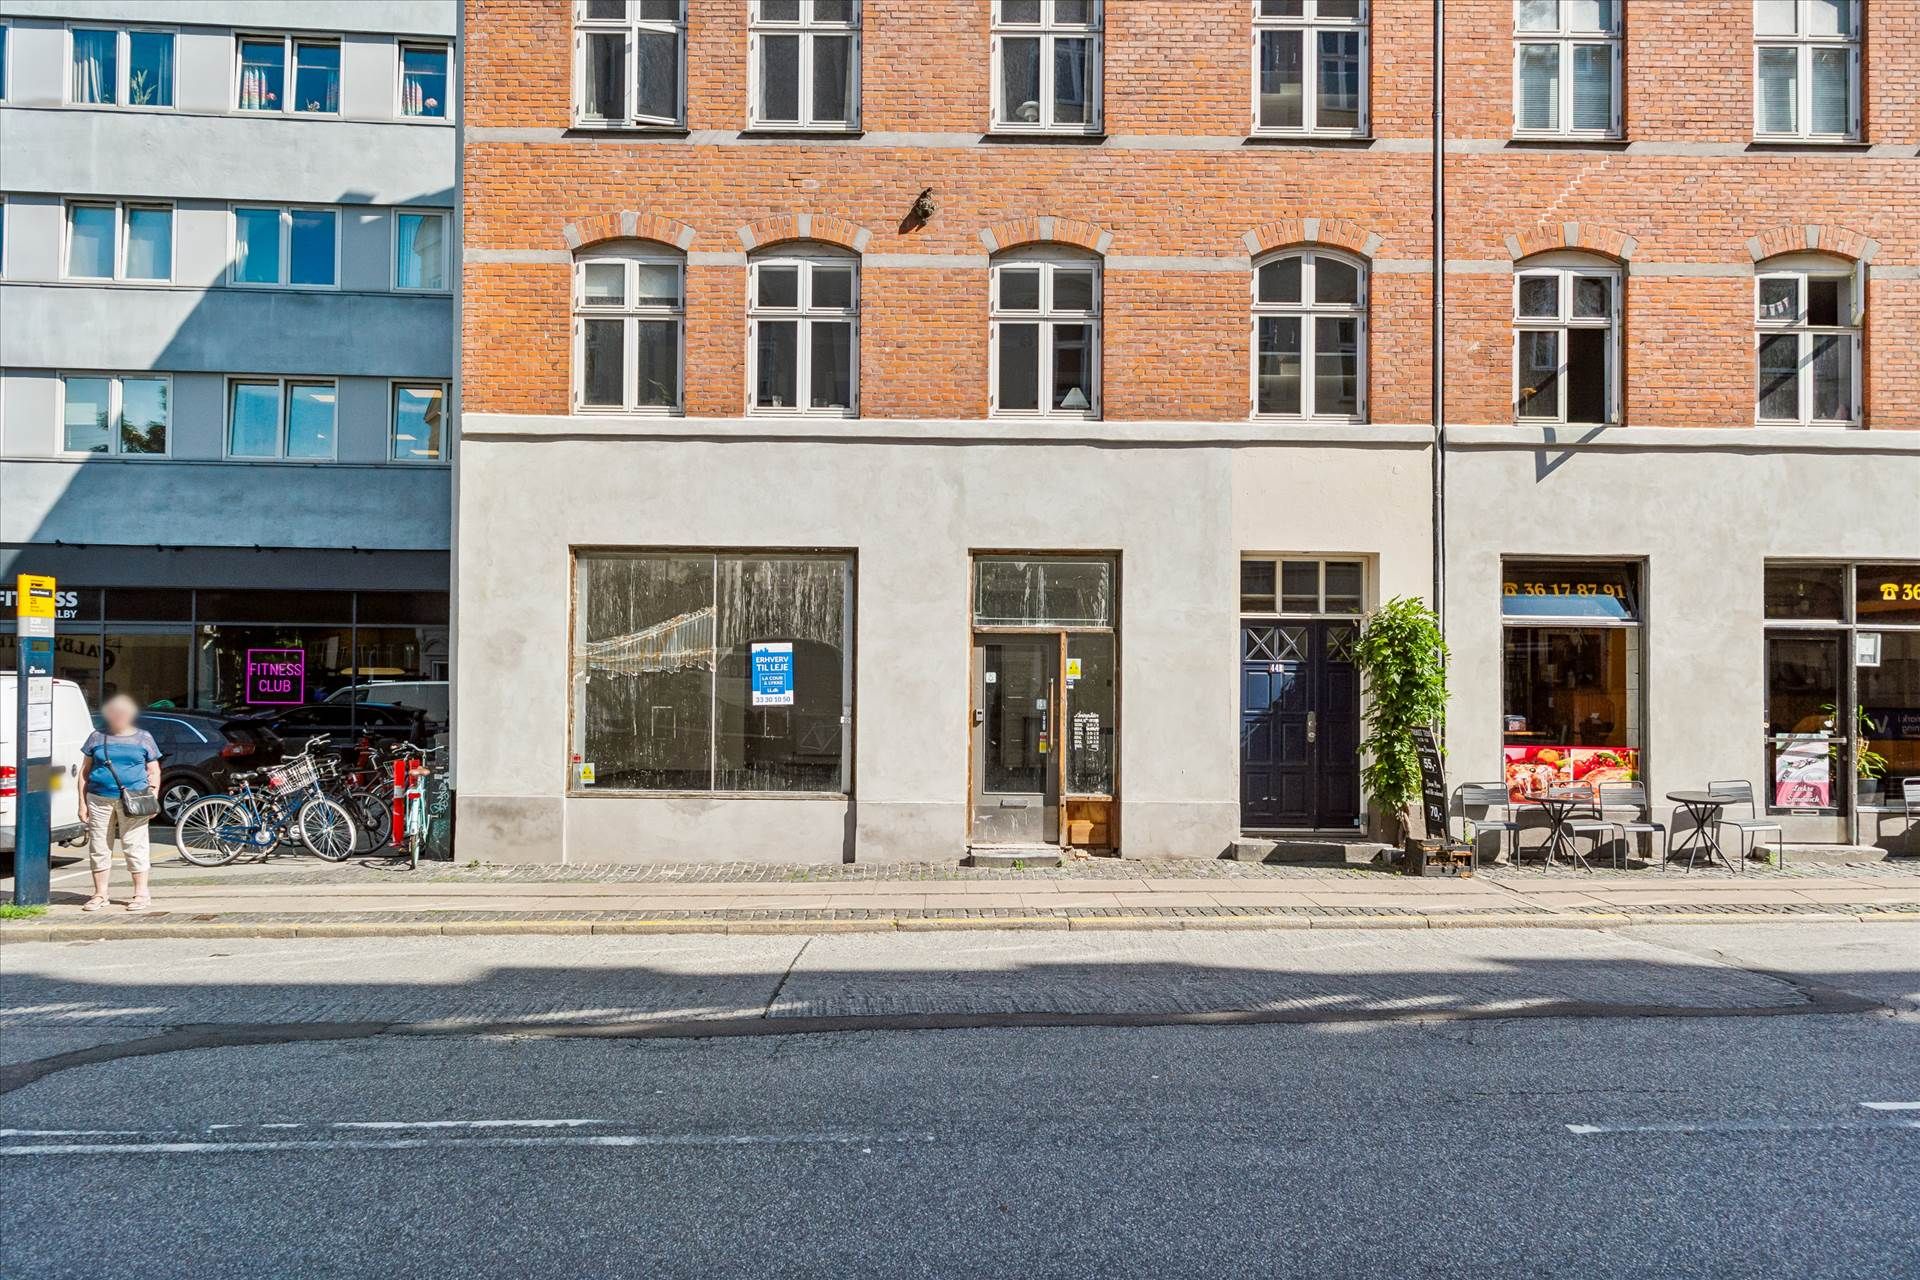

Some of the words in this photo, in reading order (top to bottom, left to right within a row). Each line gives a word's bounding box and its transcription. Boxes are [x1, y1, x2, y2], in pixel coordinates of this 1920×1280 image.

[1524, 583, 1546, 597] 36
[1550, 583, 1571, 598] 17
[1576, 583, 1597, 598] 87
[1603, 584, 1626, 599] 91
[1902, 583, 1920, 601] 36
[250, 662, 302, 676] FITNESS
[757, 664, 769, 672] TIL
[259, 679, 291, 692] CLUB
